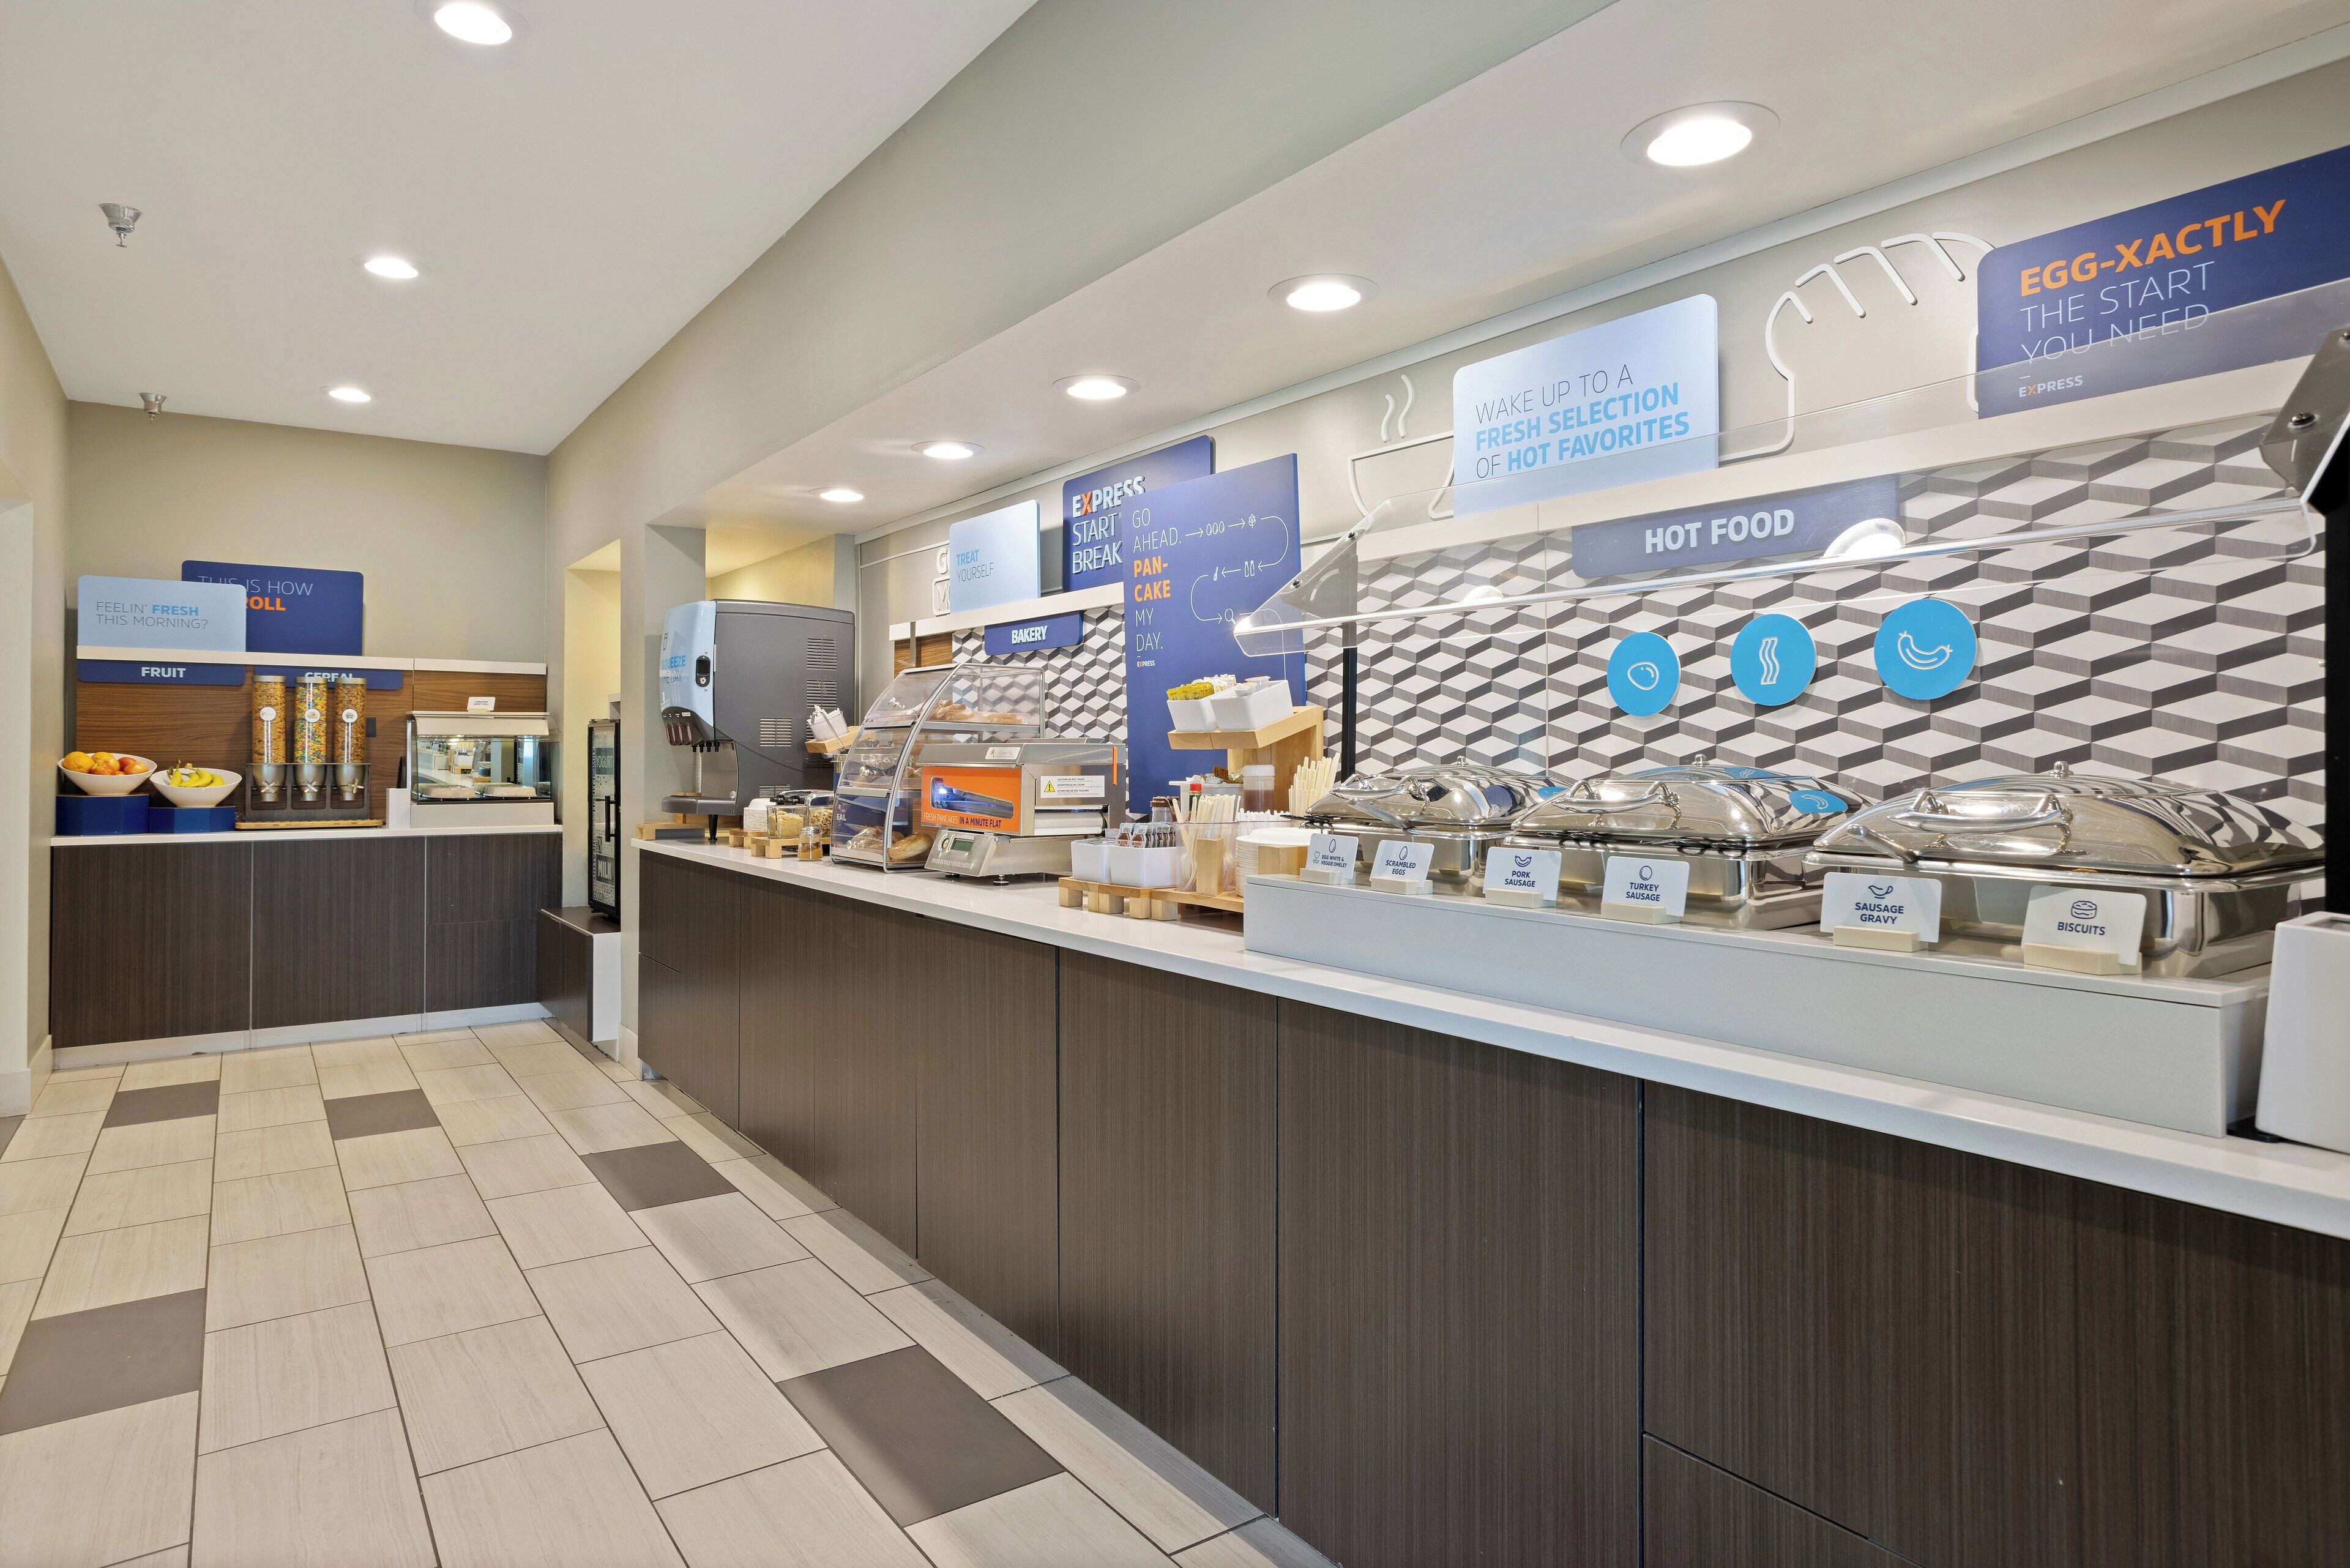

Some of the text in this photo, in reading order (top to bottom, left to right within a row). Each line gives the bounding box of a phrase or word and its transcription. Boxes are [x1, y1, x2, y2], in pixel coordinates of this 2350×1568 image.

[2020, 199, 2286, 297] EGG-XACTLY
[2020, 261, 2215, 332] THE START
[2021, 304, 2210, 365] YOU NEED
[1475, 364, 1633, 424] WAKE UP TO A
[2019, 375, 2084, 398] EXPRESS
[1475, 382, 1679, 452] FRESH SELECTION
[1476, 411, 1690, 479] OF HOT FAVORITES
[1073, 476, 1144, 518] EXPRESS
[1132, 507, 1151, 528] GO
[1133, 527, 1182, 554] AHEAD.
[1645, 509, 1795, 554] HOT FOOD
[956, 549, 979, 566] TREAT
[1073, 540, 1122, 574] BREAK
[1133, 555, 1168, 578] PAN-
[957, 562, 994, 583] YOURSELF
[246, 578, 261, 593] IS
[267, 580, 313, 596] HOW
[1134, 580, 1171, 602] CAKE
[152, 604, 199, 616] FRESH
[1135, 607, 1154, 627] MY
[95, 614, 209, 629] THIS MORNING?
[1012, 625, 1048, 644] BAKERY
[1136, 632, 1163, 652] DAY.
[141, 666, 187, 678] FRUIT
[671, 670, 683, 683] DAY
[595, 755, 613, 768] YOGURT
[923, 812, 936, 821] FRESH
[937, 813, 958, 824] PANCAKES
[970, 818, 988, 827] MINUTE
[990, 819, 1002, 828] FLAT
[597, 859, 612, 880] MILK
[1385, 860, 1416, 869] SCRAMBLED
[1511, 870, 1531, 879] PORK
[1504, 878, 1536, 888] SAUSAGE
[1629, 881, 1660, 892] TURKEY
[1625, 890, 1661, 902] SAUSAGE
[1854, 902, 1904, 915] SAUSAGE
[1859, 913, 1898, 925] GRAVY
[2056, 921, 2106, 936] BISCUITS
